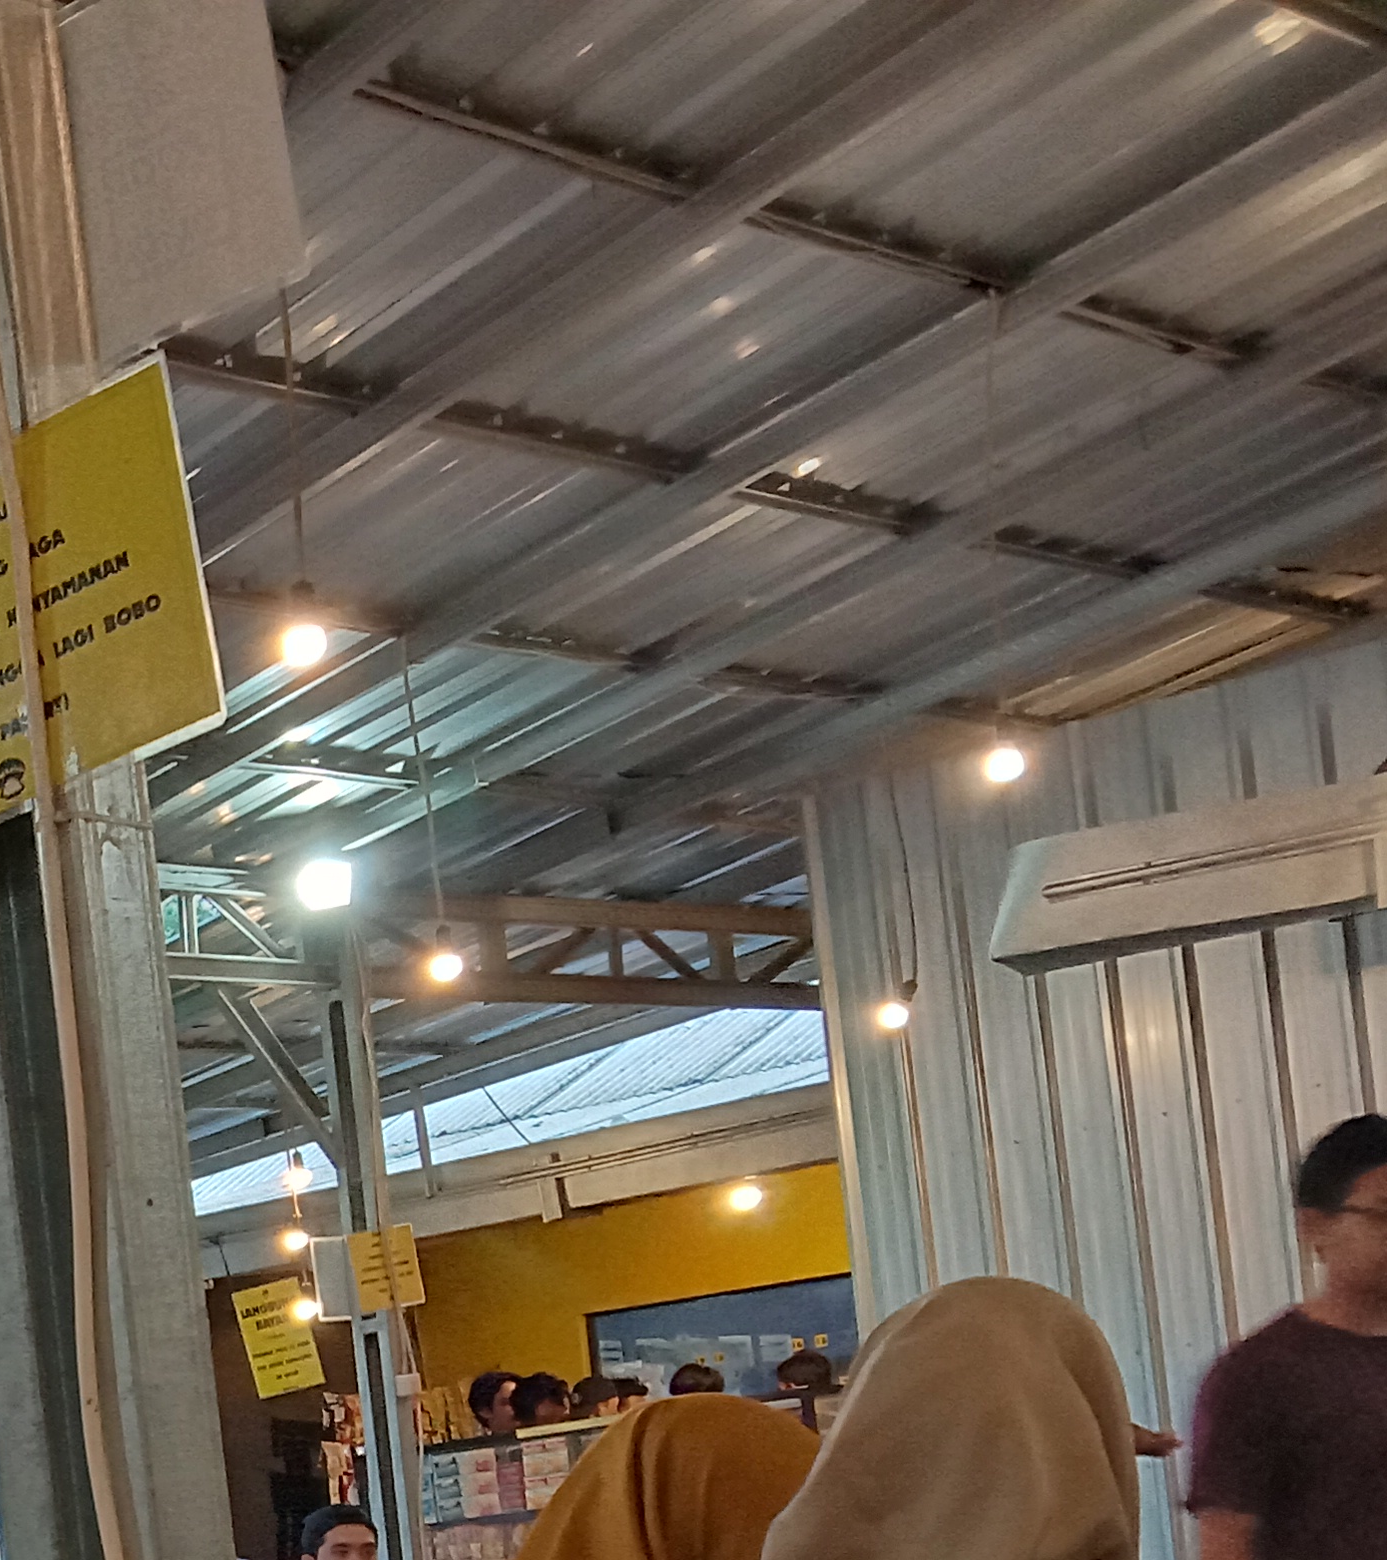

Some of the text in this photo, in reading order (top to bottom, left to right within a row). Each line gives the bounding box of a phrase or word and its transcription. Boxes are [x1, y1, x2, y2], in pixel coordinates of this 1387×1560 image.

[29, 528, 65, 563] AGA
[6, 551, 130, 628] KNYAMANAN
[53, 624, 95, 658] LAGI
[103, 594, 161, 634] BOBO
